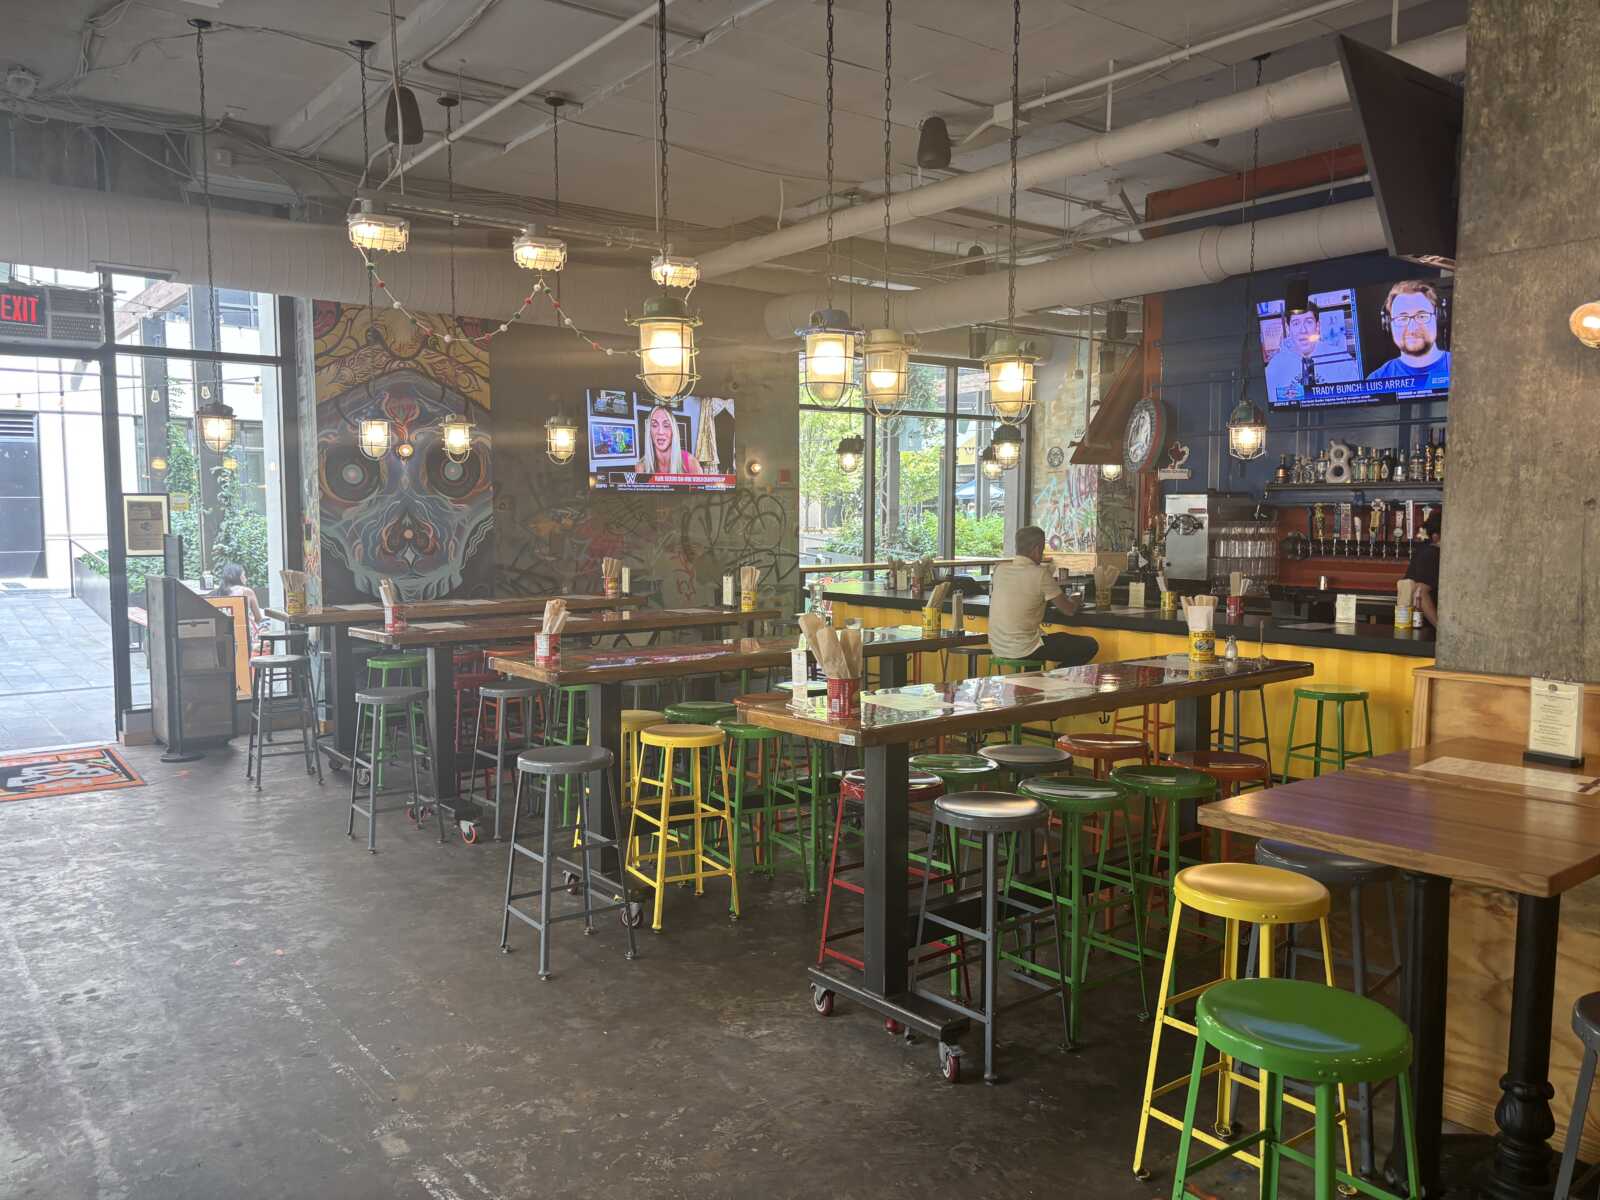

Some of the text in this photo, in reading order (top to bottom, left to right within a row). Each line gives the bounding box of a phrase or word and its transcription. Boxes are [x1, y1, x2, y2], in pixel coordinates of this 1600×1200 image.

[0, 294, 39, 324] EXIT
[1311, 385, 1335, 396] TRADY
[1366, 381, 1383, 391] LUIS
[1384, 378, 1416, 390] ARRAEZ
